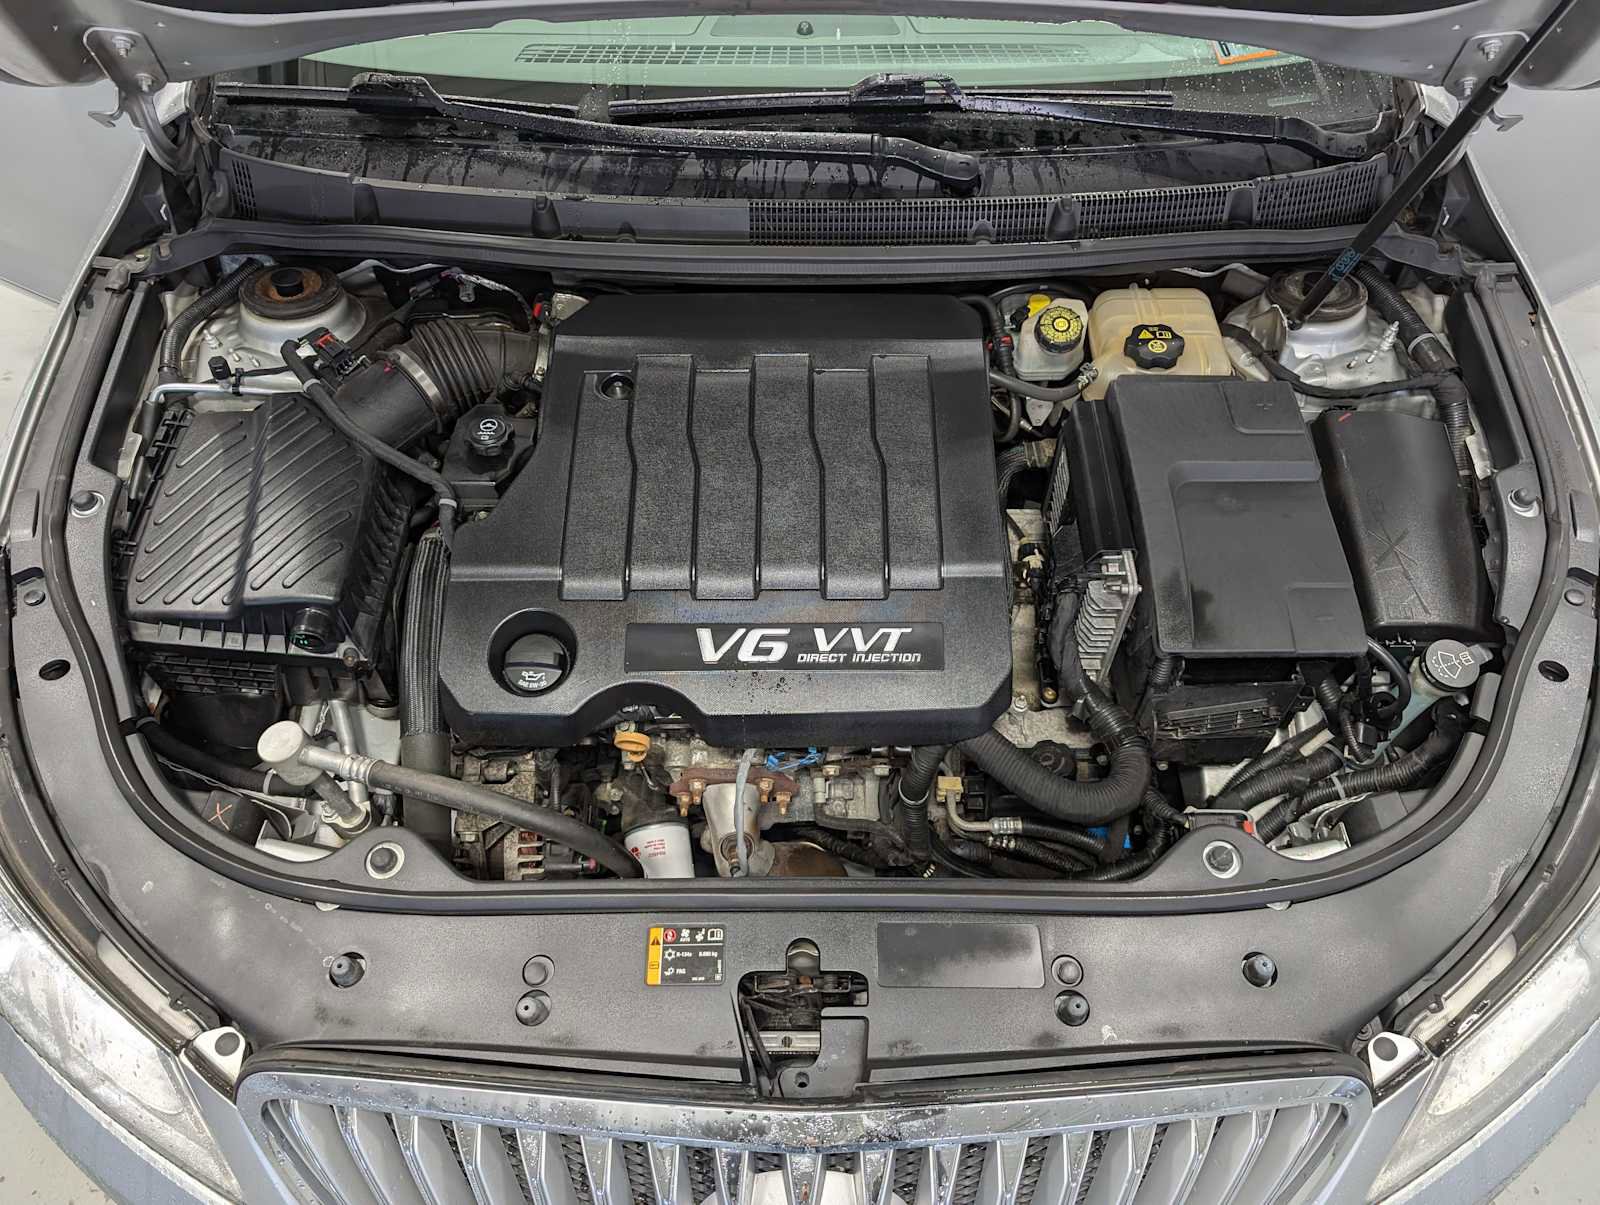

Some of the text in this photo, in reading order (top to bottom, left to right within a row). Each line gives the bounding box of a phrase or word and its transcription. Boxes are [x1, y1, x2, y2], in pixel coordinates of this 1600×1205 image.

[695, 627, 913, 664] V6 VVT
[796, 653, 922, 663] DIRECT INJECTION
